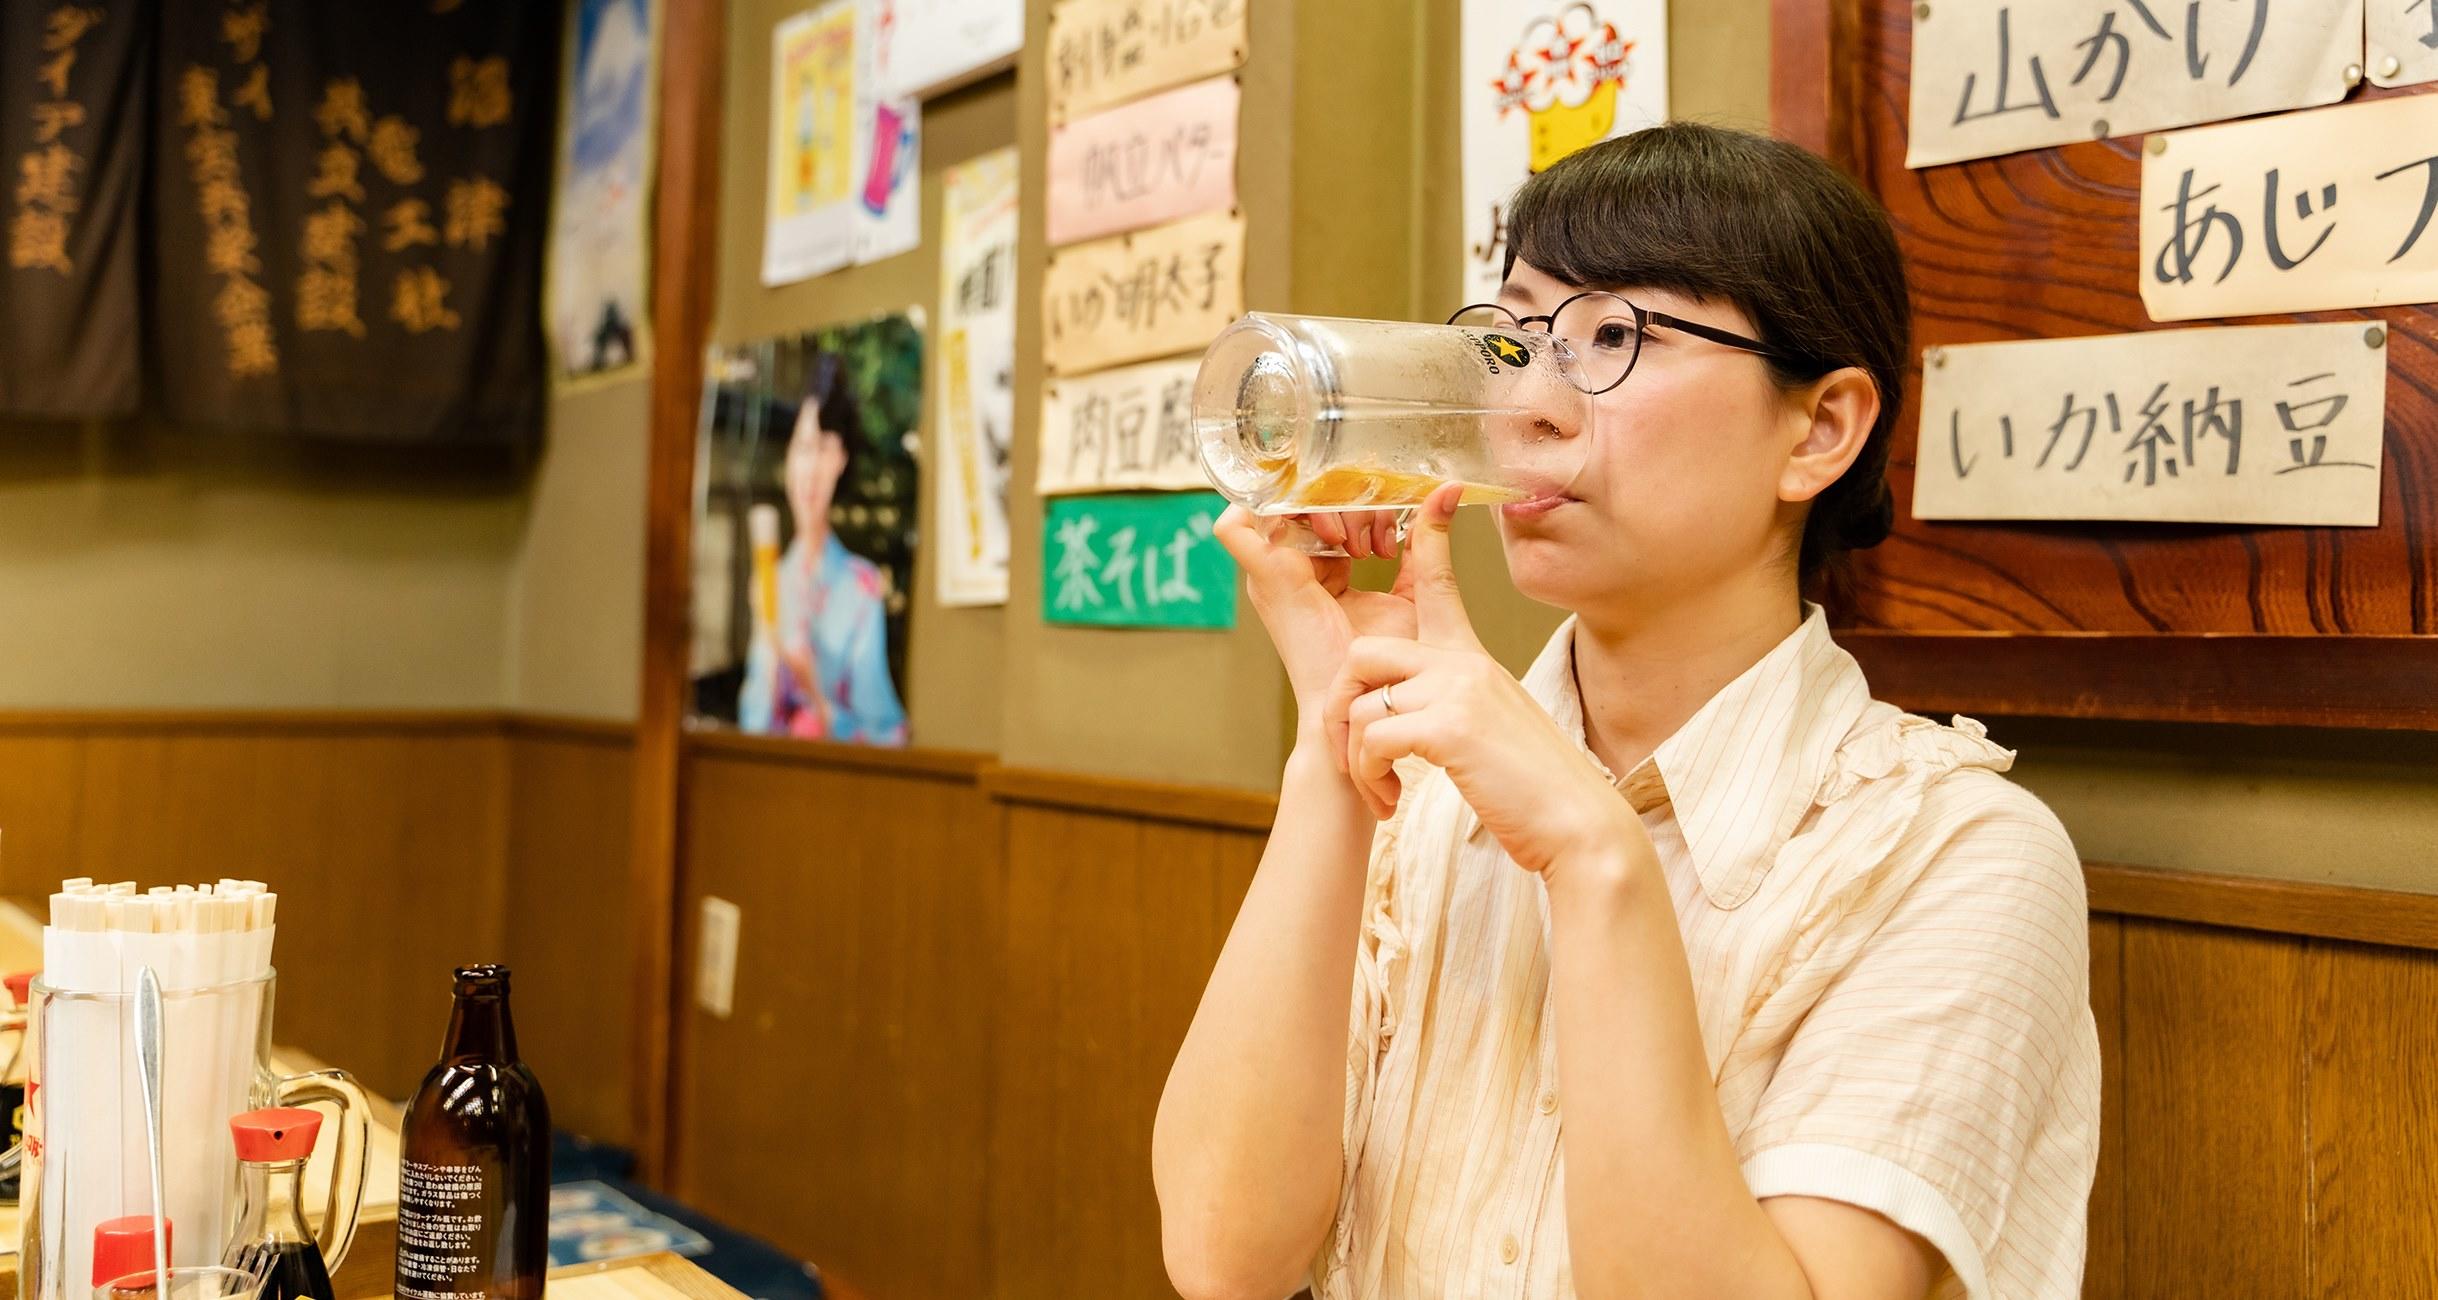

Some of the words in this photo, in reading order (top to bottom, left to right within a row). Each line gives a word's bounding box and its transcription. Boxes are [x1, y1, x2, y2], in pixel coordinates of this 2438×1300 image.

[1049, 241, 1226, 341] いか明太子
[1951, 373, 2376, 487] いか納豆
[1054, 512, 1213, 613] 茶そば
